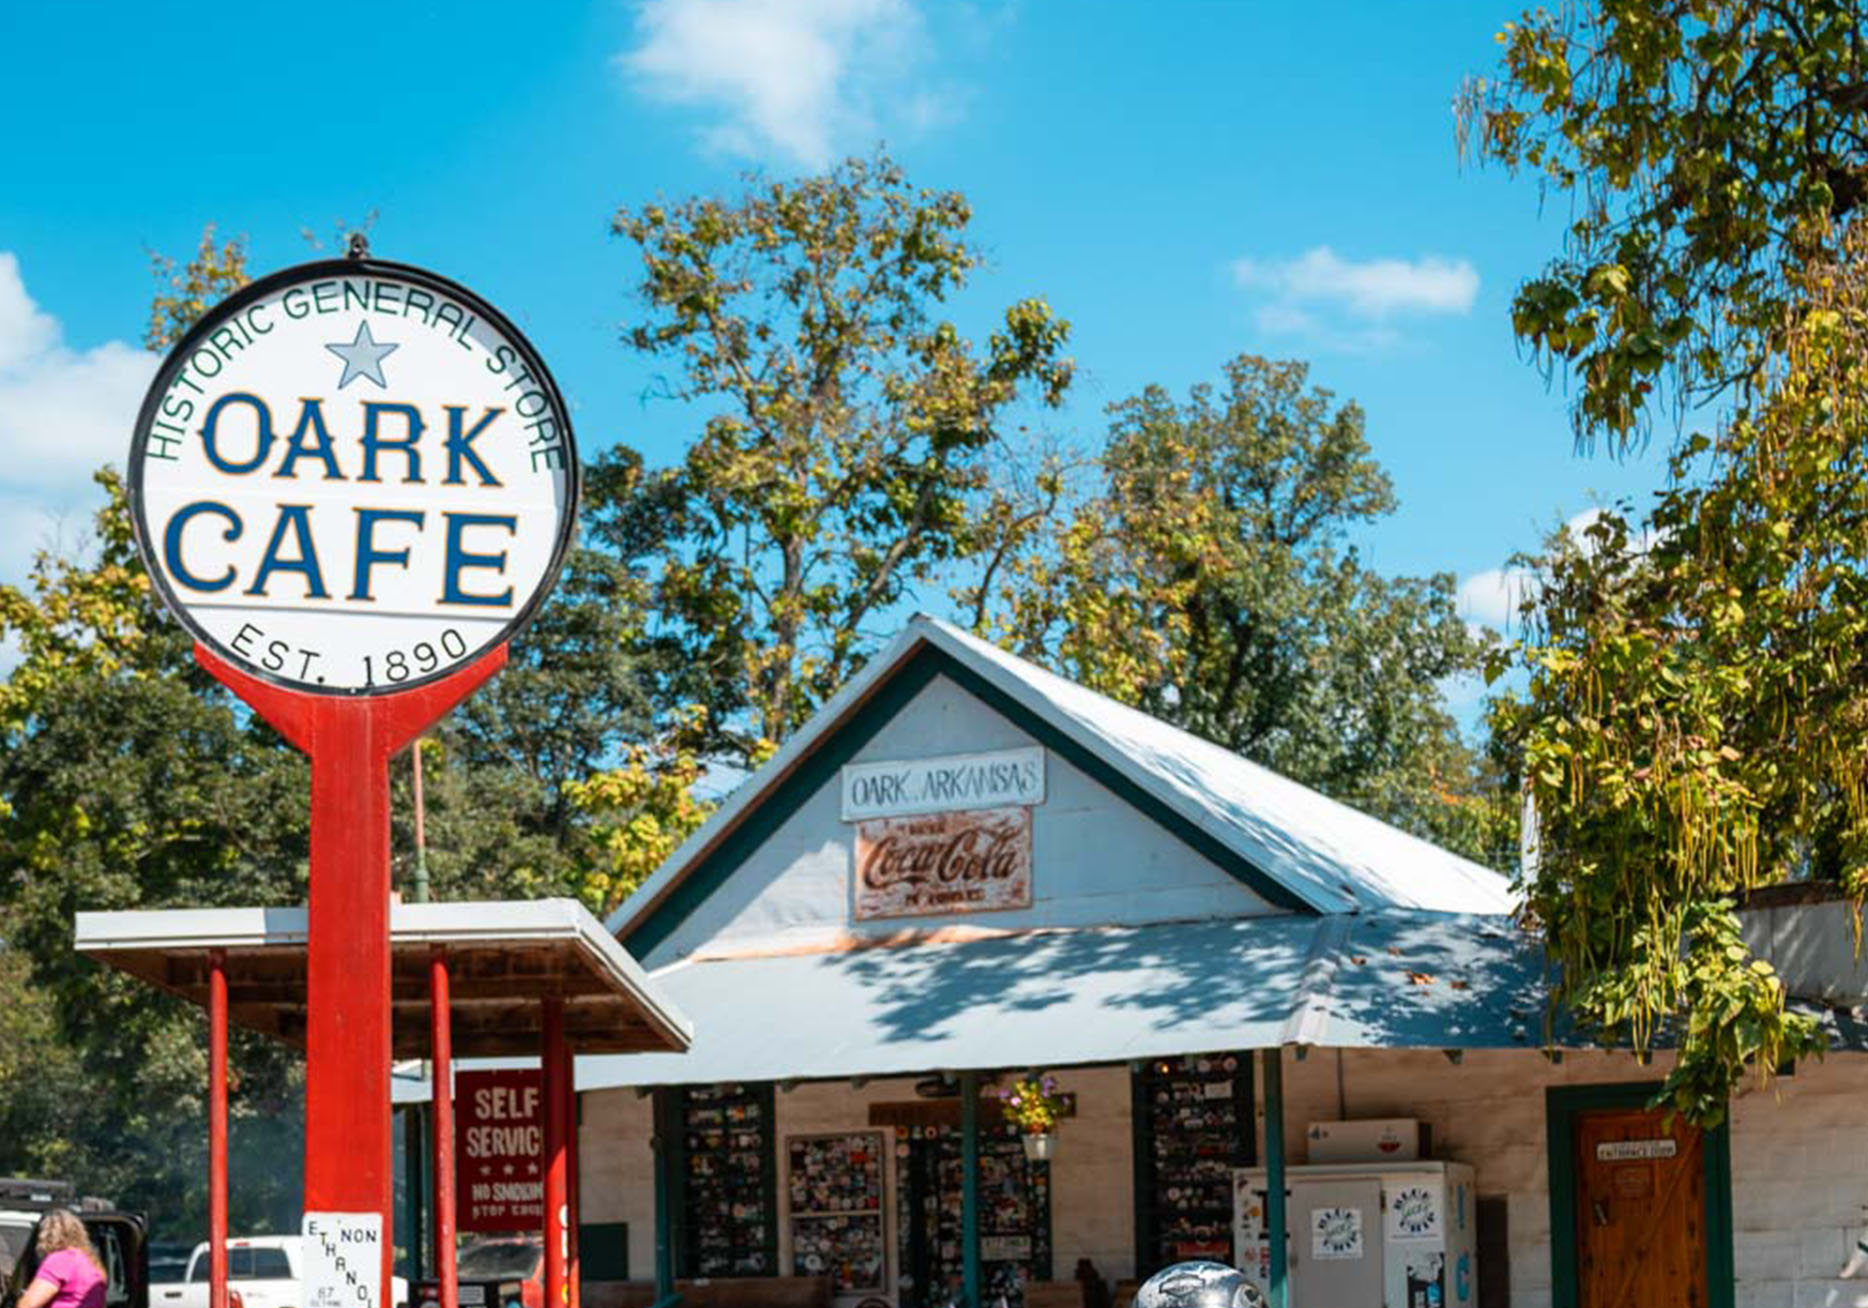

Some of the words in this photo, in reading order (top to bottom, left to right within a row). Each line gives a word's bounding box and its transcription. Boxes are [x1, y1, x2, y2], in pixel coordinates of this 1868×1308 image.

[147, 304, 275, 461] HISTORIC
[282, 279, 472, 351] GENERAL
[486, 344, 565, 473] STORE
[197, 392, 506, 488] OARK
[163, 500, 518, 608] CAFE
[231, 623, 325, 684] EST.
[363, 628, 467, 686] 1890
[922, 761, 1036, 800] ARKANSAS
[475, 1086, 539, 1120] SELF
[466, 1124, 543, 1158] SERVIC
[472, 1182, 491, 1201] NO
[492, 1181, 543, 1201] SMOKIN
[341, 1228, 377, 1244] NON
